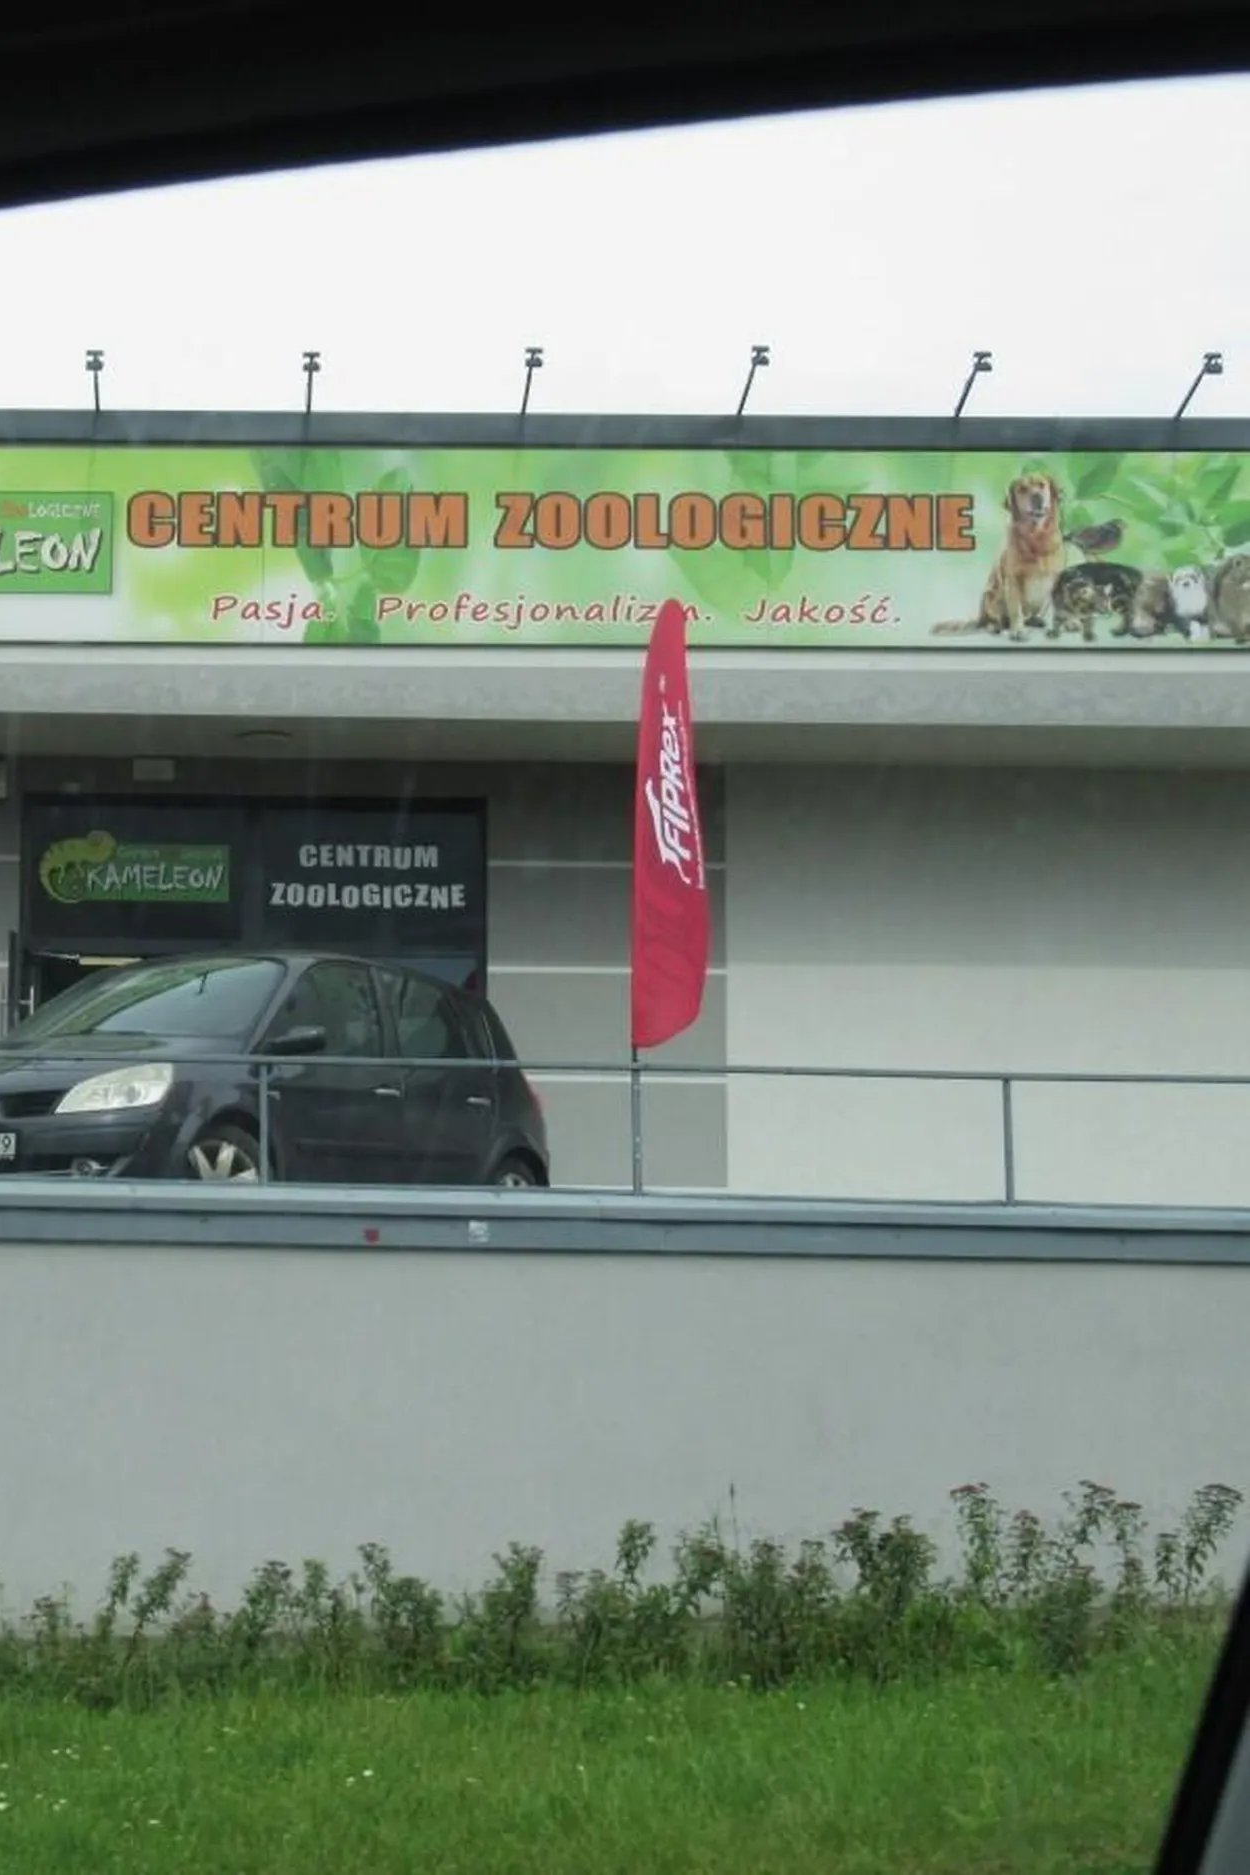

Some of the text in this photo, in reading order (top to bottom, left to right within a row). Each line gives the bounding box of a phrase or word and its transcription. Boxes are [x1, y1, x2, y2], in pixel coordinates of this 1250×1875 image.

[127, 491, 976, 551] CENTRUM ZOOLOGICZNE
[212, 594, 335, 632] Pasja.
[745, 595, 902, 627] Jakość.
[299, 844, 439, 869] CENTRUM
[87, 861, 224, 892] KAMELEON
[269, 883, 466, 909] ZOOLOGICZNE
